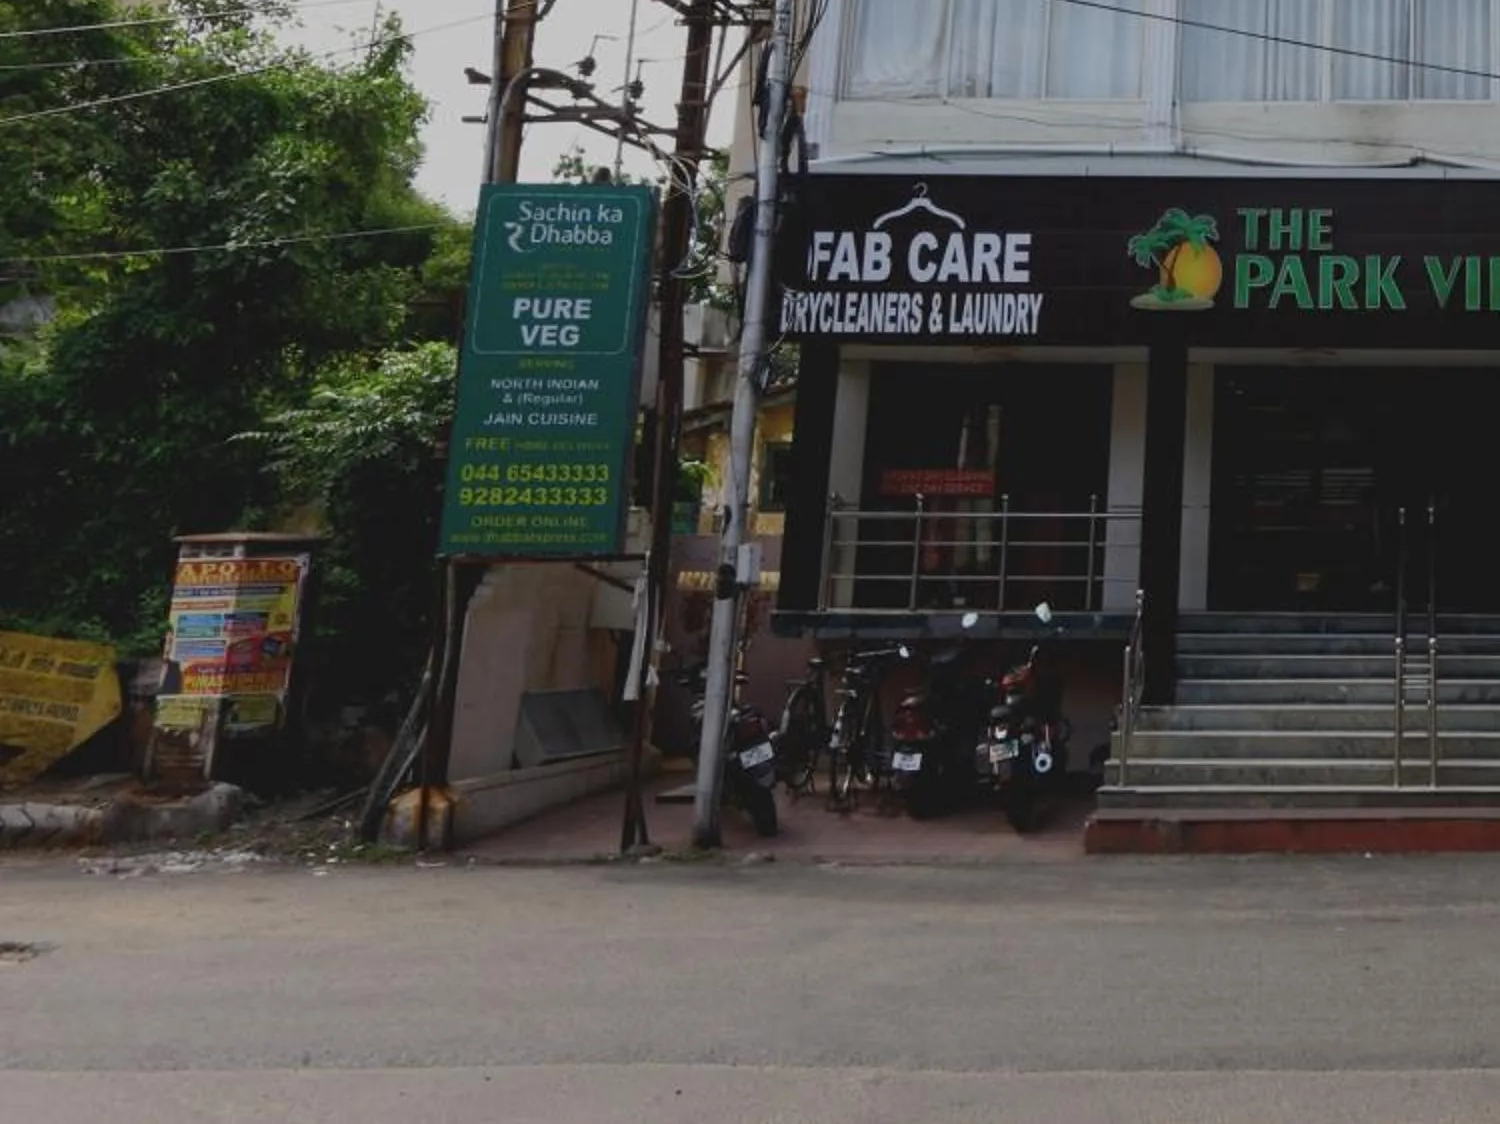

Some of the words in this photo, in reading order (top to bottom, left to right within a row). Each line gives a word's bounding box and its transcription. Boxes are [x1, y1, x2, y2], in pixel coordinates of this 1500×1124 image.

[519, 200, 591, 222] Sachin
[597, 203, 623, 223] ka
[531, 223, 613, 245] Dhabba
[1236, 208, 1333, 251] THE
[806, 231, 892, 282] FAB
[908, 232, 1031, 283] CARE
[1233, 254, 1407, 310] PARK
[512, 296, 593, 320] PURE
[929, 292, 943, 333] &
[948, 293, 1043, 335] LAUNDRY
[520, 324, 581, 347] VEG
[491, 378, 543, 390] NORTH
[547, 379, 600, 390] INDIAN
[517, 392, 583, 407] (Regular)
[483, 412, 523, 426] JAIN
[528, 413, 598, 426] CUISINE
[464, 437, 511, 451] FREE
[461, 463, 500, 482] 044
[506, 463, 609, 482] 65433333
[459, 487, 607, 506] 9282433333
[471, 515, 527, 528] ORDER
[531, 516, 588, 528] ONLINE
